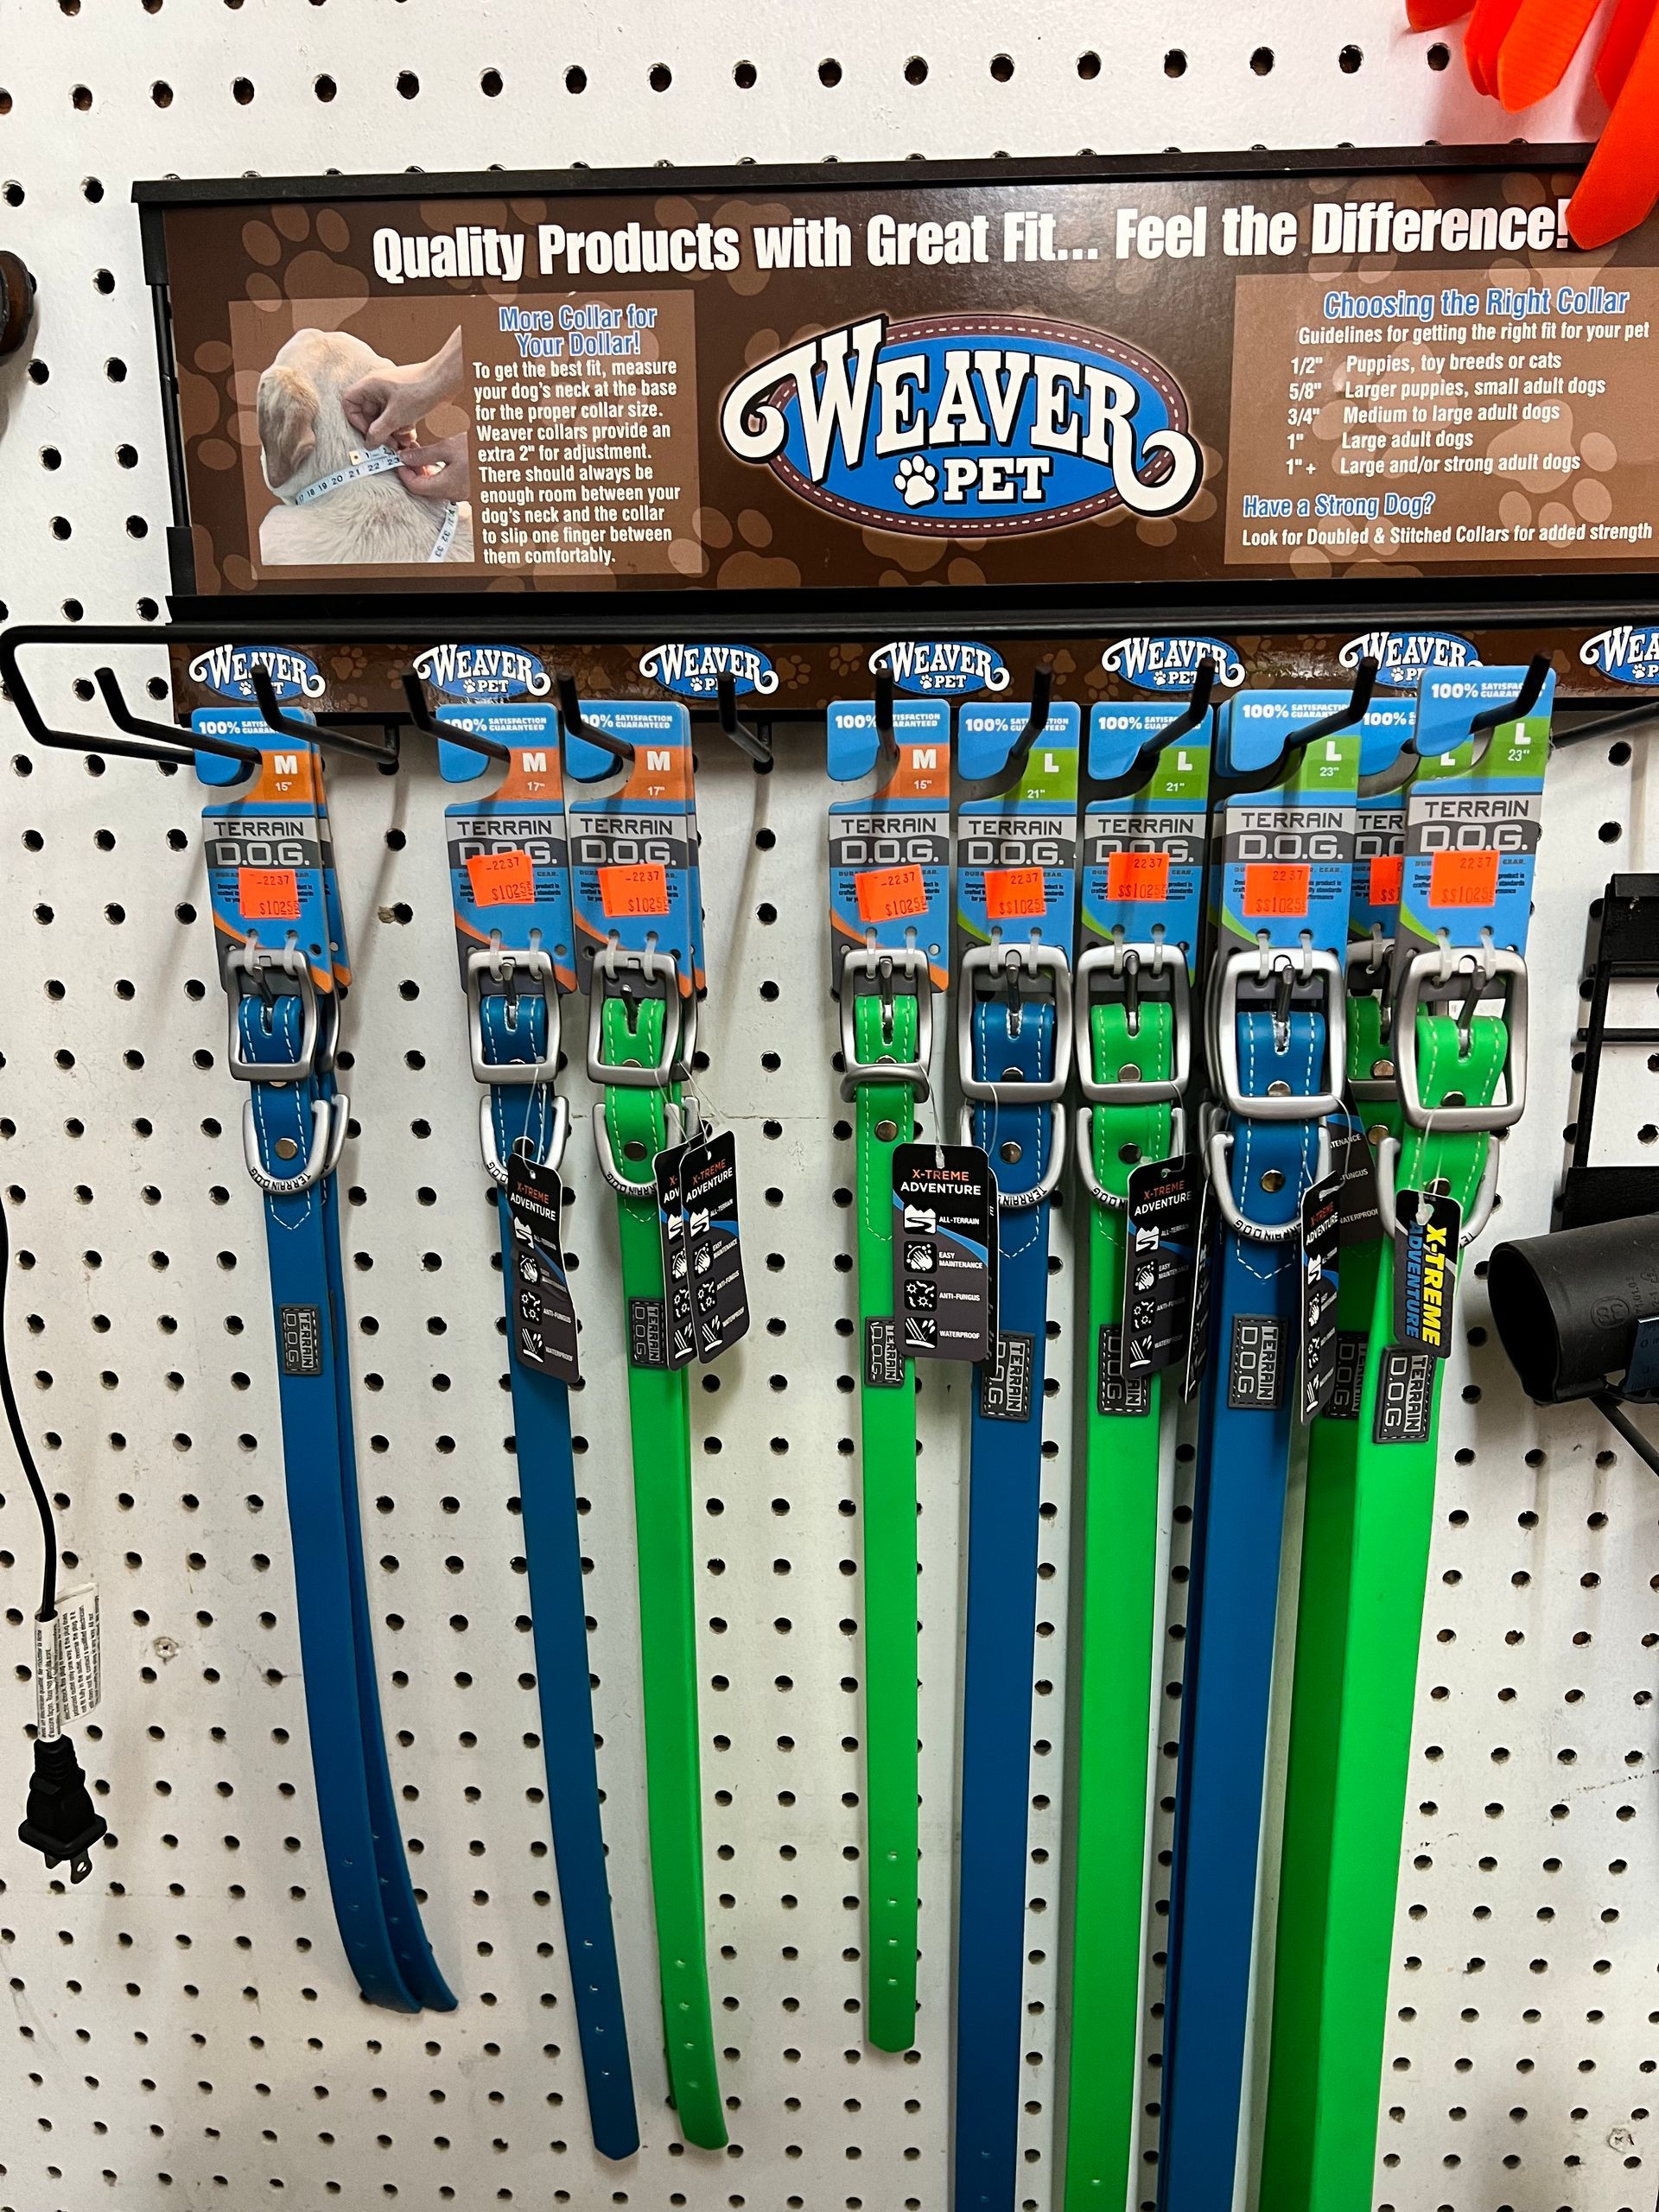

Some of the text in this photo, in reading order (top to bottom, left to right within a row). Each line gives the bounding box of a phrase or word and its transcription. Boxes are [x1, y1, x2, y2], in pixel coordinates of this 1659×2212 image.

[373, 198, 1568, 283] Quality Products with Great Fit... Feel the Difference!
[1324, 286, 1630, 322] Choosing the Right Collar
[499, 303, 658, 332] More Collar for
[516, 331, 640, 357] Your Dollar!
[1299, 321, 1649, 346] Guidelines for getting the right fit for your pet
[473, 359, 676, 382] To get the best fit, measure
[1291, 353, 1561, 376] 1/2" Puppies, toy breeds or cats
[474, 379, 676, 403] your dog's neck at the base
[1289, 377, 1605, 401] 5/8" Larger puppies, small adult dogs
[475, 401, 663, 423] for the proper collar size.
[721, 314, 1204, 516] WEAVER
[1287, 403, 1560, 426] 3/4" Medium to large adult dogs
[1287, 430, 1472, 451] 1" Large adult dogs
[1286, 453, 1580, 477] 1" + Large and/or strong adult dogs
[944, 458, 1050, 501] PET
[1243, 492, 1436, 519] Have a Strong Dog?
[1243, 523, 1652, 545] Look for Doubled & Stitched Collars for added strength
[189, 644, 327, 698] WEAVER
[413, 644, 551, 696] WEAVER
[639, 643, 779, 695] WEAVER
[868, 640, 1011, 692] WEAVER
[478, 679, 510, 693] PET
[935, 675, 967, 688] PET
[1432, 683, 1478, 699] 100%
[1243, 704, 1289, 719] 100%
[1099, 717, 1142, 731] 100%
[1514, 722, 1531, 745] L
[647, 751, 671, 771] M
[912, 749, 937, 769] M
[1178, 751, 1193, 772] L
[1325, 741, 1342, 761] L
[1507, 749, 1530, 761] 23"
[275, 754, 298, 775] M
[522, 753, 547, 772] M
[1044, 753, 1059, 772] L
[1319, 766, 1339, 777] 23"
[275, 781, 293, 792] 15"
[527, 781, 545, 791] 17"
[647, 786, 664, 796] 17"
[913, 779, 932, 790] 15"
[1027, 789, 1046, 798] 21"
[1166, 782, 1185, 792] 21"
[1425, 800, 1529, 818] TERRAIN
[213, 822, 304, 836] TERRAIN
[457, 820, 552, 836] TERRAIN
[580, 818, 673, 836] TERRAIN
[842, 817, 937, 835] TERRAIN
[969, 820, 1063, 836] TERRAIN
[1098, 817, 1194, 834] TERRAIN
[1242, 812, 1343, 829] TERRAIN
[1238, 835, 1344, 860] D.O.G.
[1420, 824, 1529, 853] D.O.G.
[215, 842, 310, 866] D.O.G.
[581, 840, 677, 866] D.O.G.
[841, 840, 939, 864] D.O.G.
[968, 841, 1065, 865] D.O.G.
[912, 1168, 970, 1182] X-TREME
[900, 1181, 982, 1196] ADVENTURE
[938, 1216, 980, 1225] ALL-TERRAIN
[938, 1251, 956, 1260] EASY
[938, 1259, 983, 1269] MAINTENANCE
[1406, 1219, 1424, 1339] ADVENTURE
[1422, 1223, 1447, 1347] X-TREME
[938, 1293, 981, 1301] ANTI-FUNGUS
[939, 1330, 981, 1340] WATERPROOF
[1236, 1326, 1259, 1399] D.O.G.
[1256, 1325, 1279, 1401] TERRAIN
